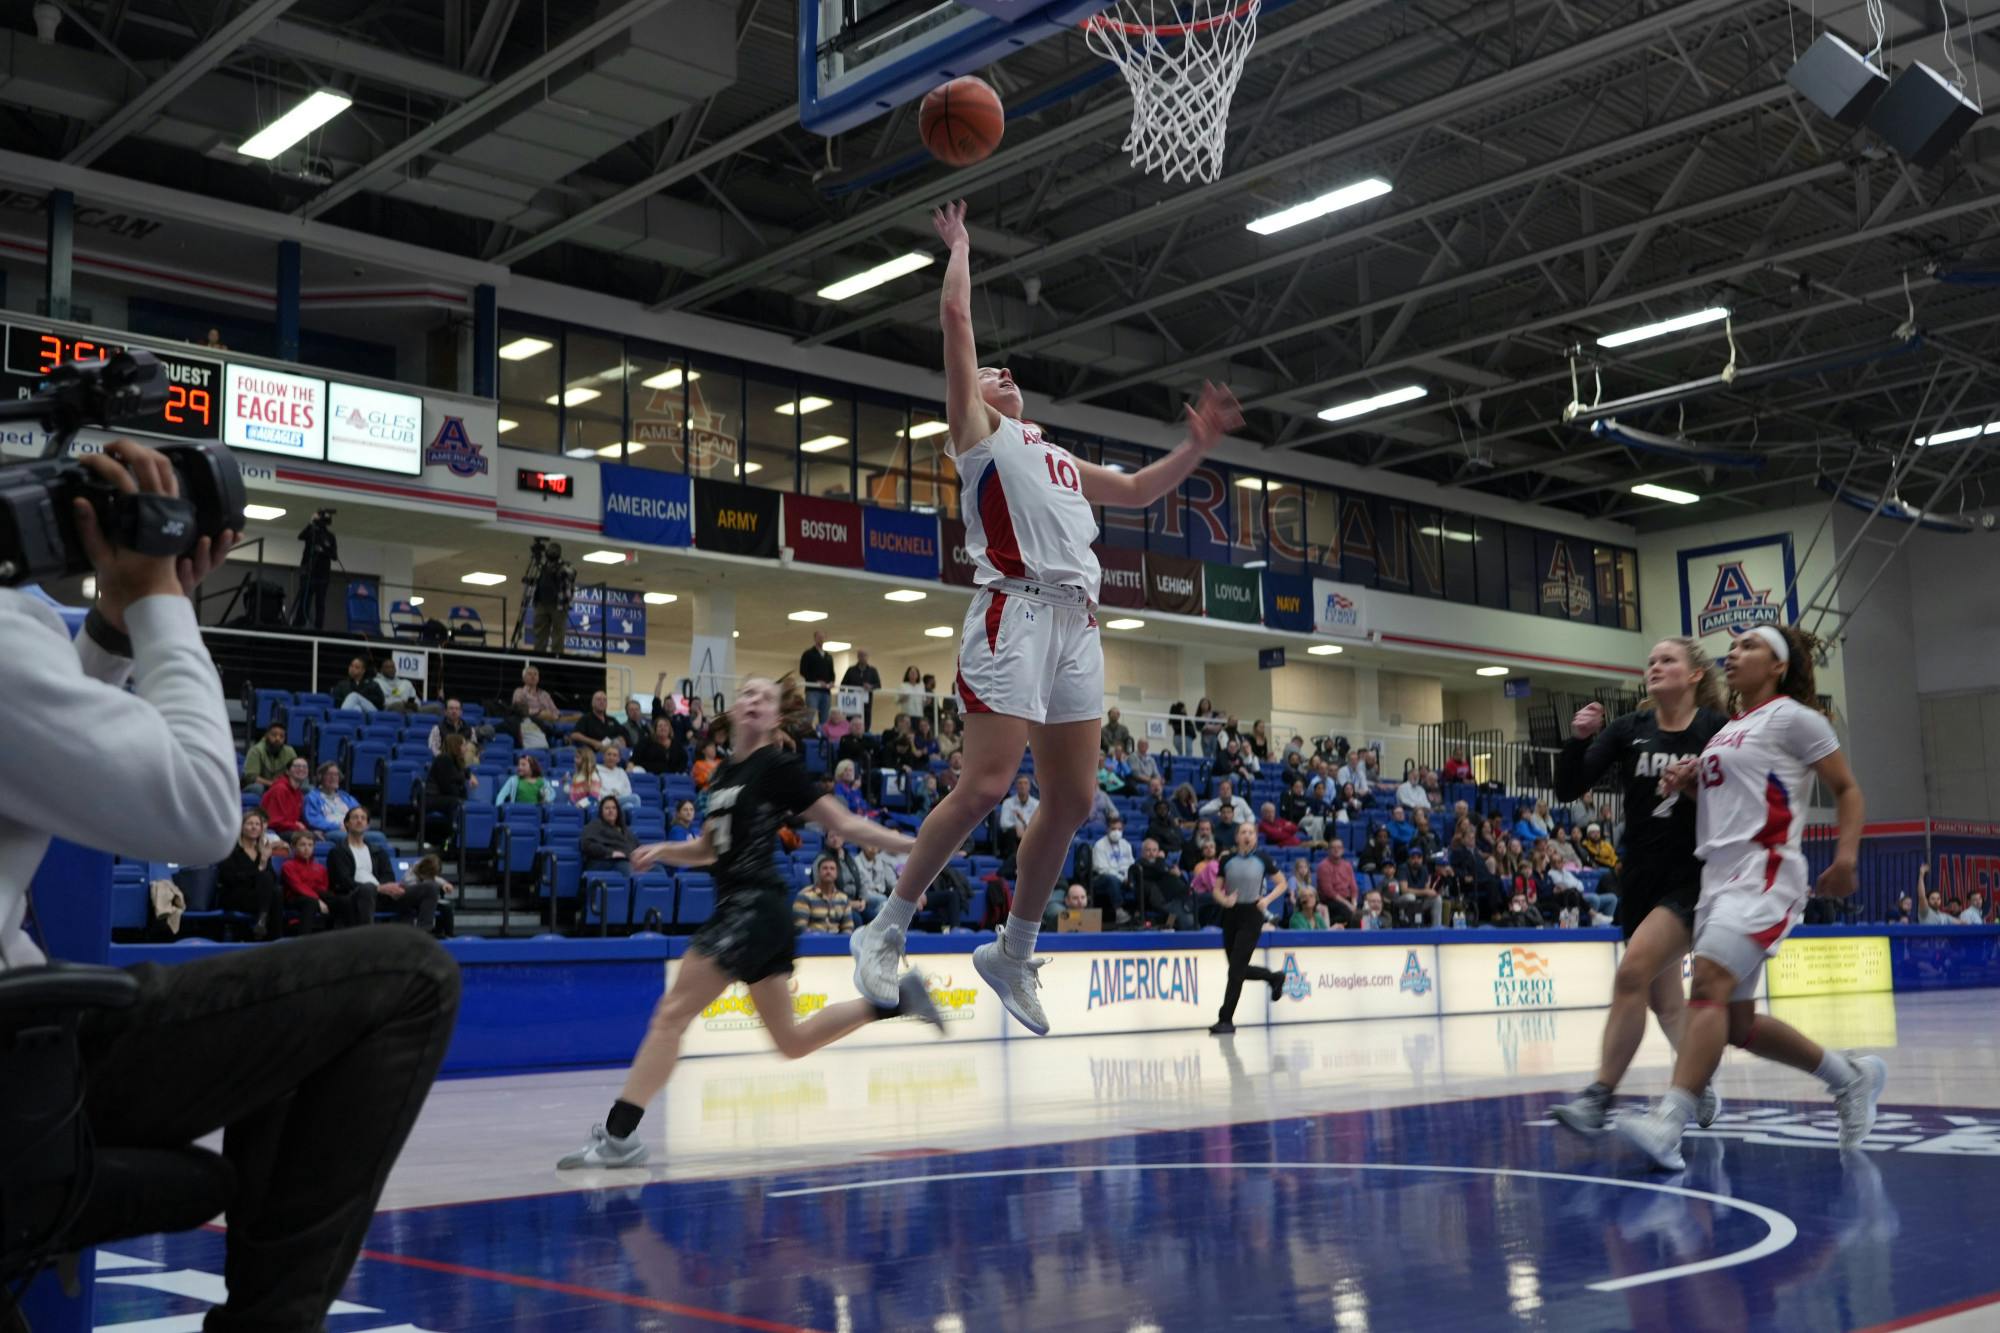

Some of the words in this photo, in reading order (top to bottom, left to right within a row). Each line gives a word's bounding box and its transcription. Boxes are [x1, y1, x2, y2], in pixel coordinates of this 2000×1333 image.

[237, 375, 288, 397] FOLLOW
[292, 386, 315, 401] THE
[165, 385, 210, 426] 29
[237, 394, 315, 429] EAGLES
[369, 426, 415, 443] CLUB
[640, 425, 733, 455] AMEICAN
[432, 452, 485, 468] AMERICAN
[1045, 452, 1079, 492] 10
[607, 493, 687, 521] AMERICAN
[718, 509, 758, 532] ARMY
[801, 519, 847, 543] BOSTON
[870, 530, 934, 557] BUCKNELL
[1100, 567, 1141, 589] FAYETTE
[1156, 575, 1193, 595] LEHIGH
[590, 588, 628, 604] AENA
[1215, 584, 1250, 602] LOYOLA
[574, 603, 597, 615] EXIT
[1276, 595, 1300, 613] NAVY
[1704, 608, 1776, 630] AMERICAN
[564, 636, 615, 650] ESTROOS
[398, 656, 419, 671] 103
[842, 696, 857, 708] 104
[1087, 956, 1198, 1010] AMERICAN
[1318, 973, 1393, 990] AUeagles.com
[1494, 979, 1553, 992] PATRIOT
[1496, 993, 1556, 1006] LEAGUE
